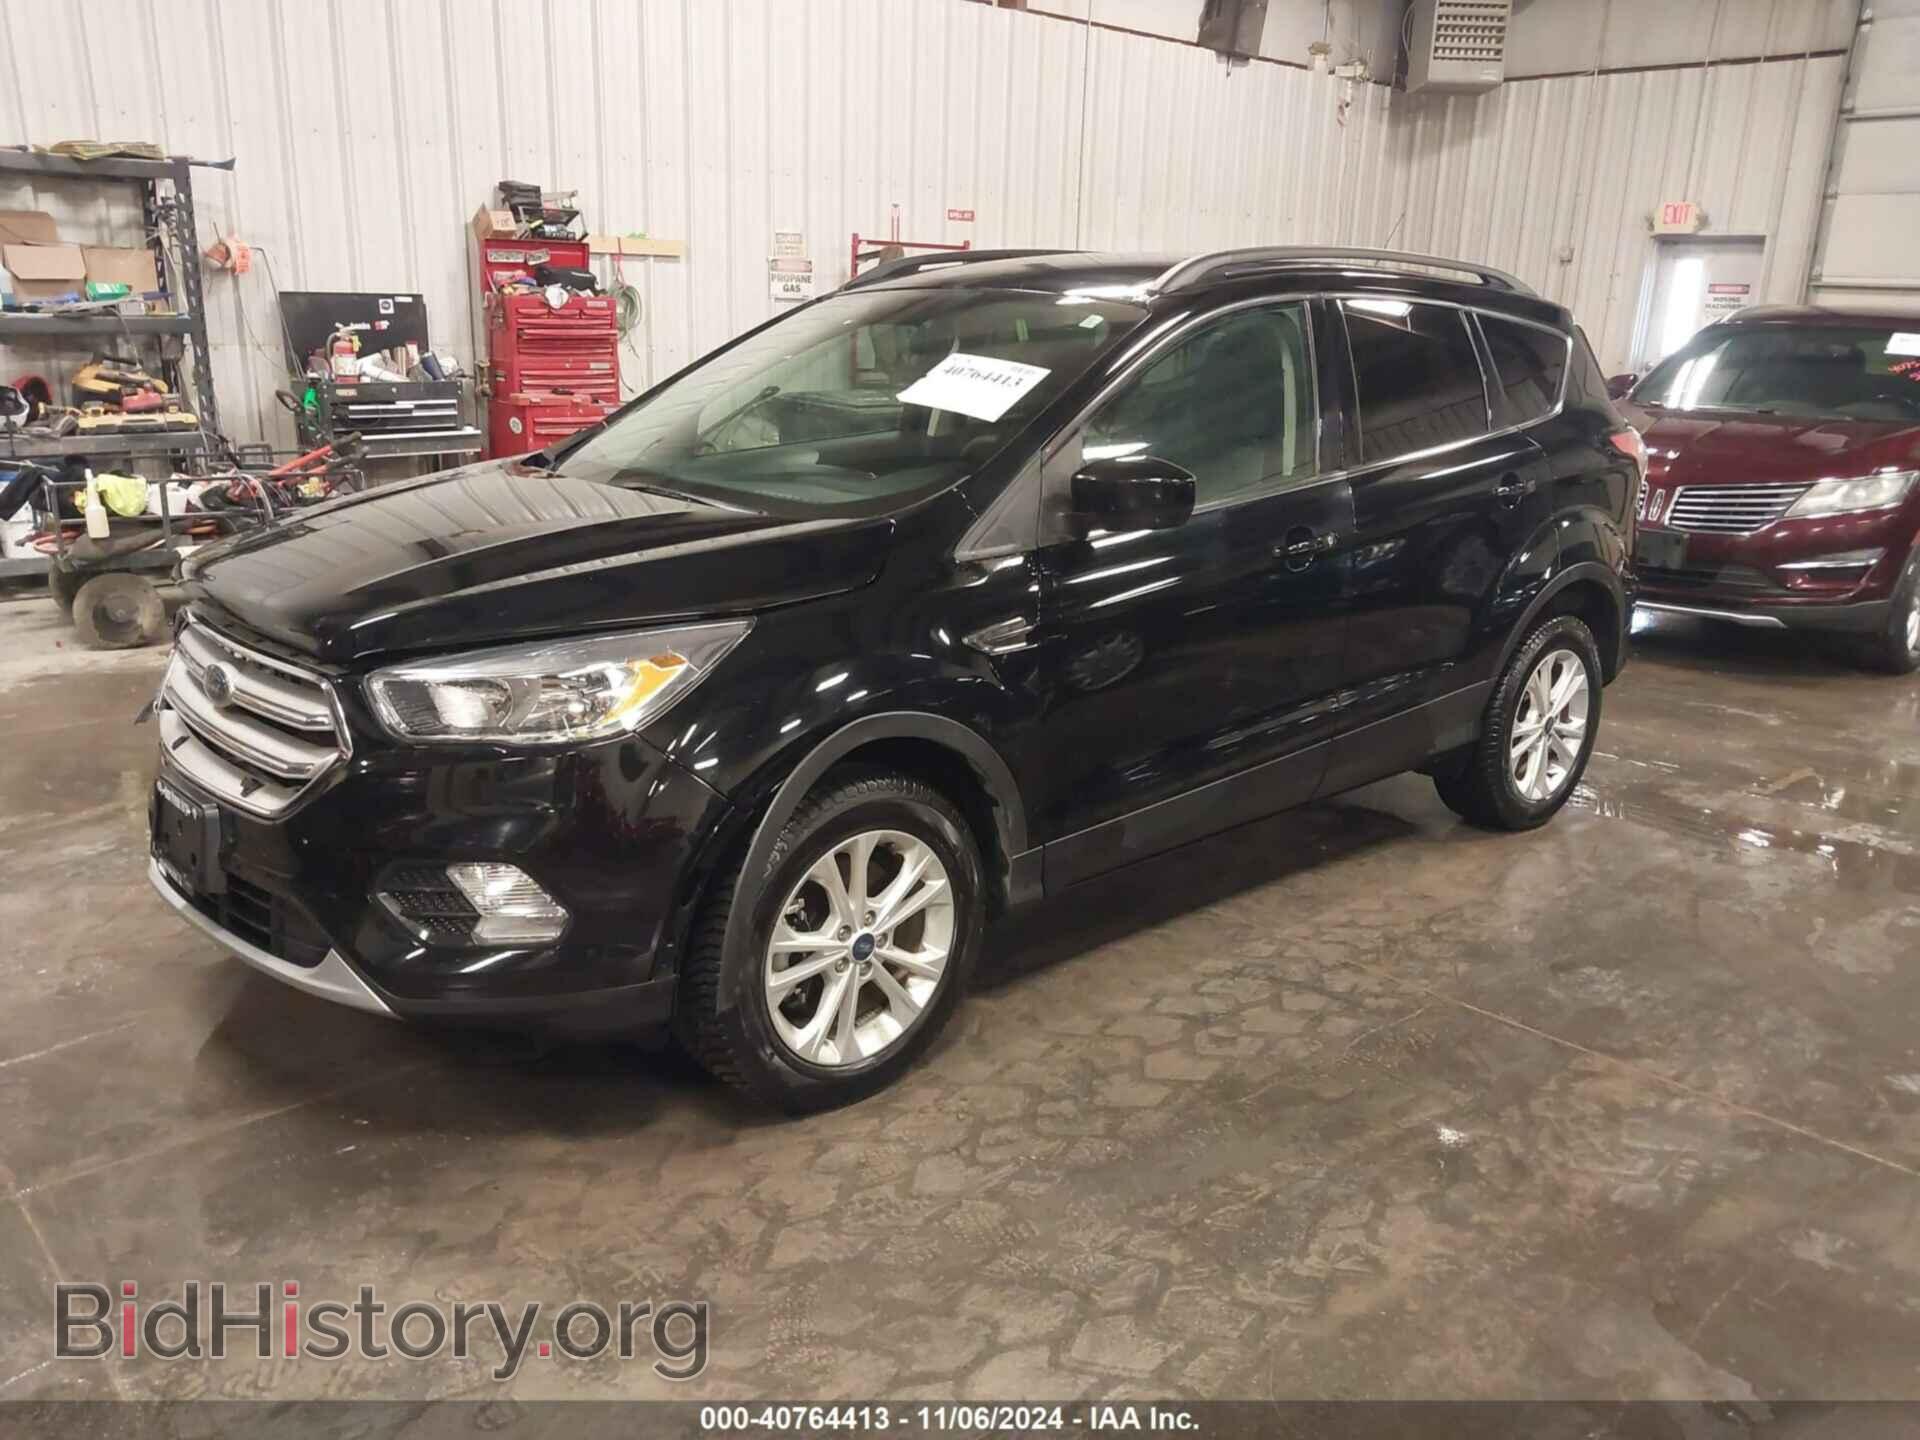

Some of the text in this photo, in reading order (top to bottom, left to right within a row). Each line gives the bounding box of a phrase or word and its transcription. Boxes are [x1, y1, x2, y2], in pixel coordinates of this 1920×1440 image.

[1663, 203, 1691, 225] EXIT
[771, 273, 812, 284] PROPANE
[783, 283, 801, 293] GAS
